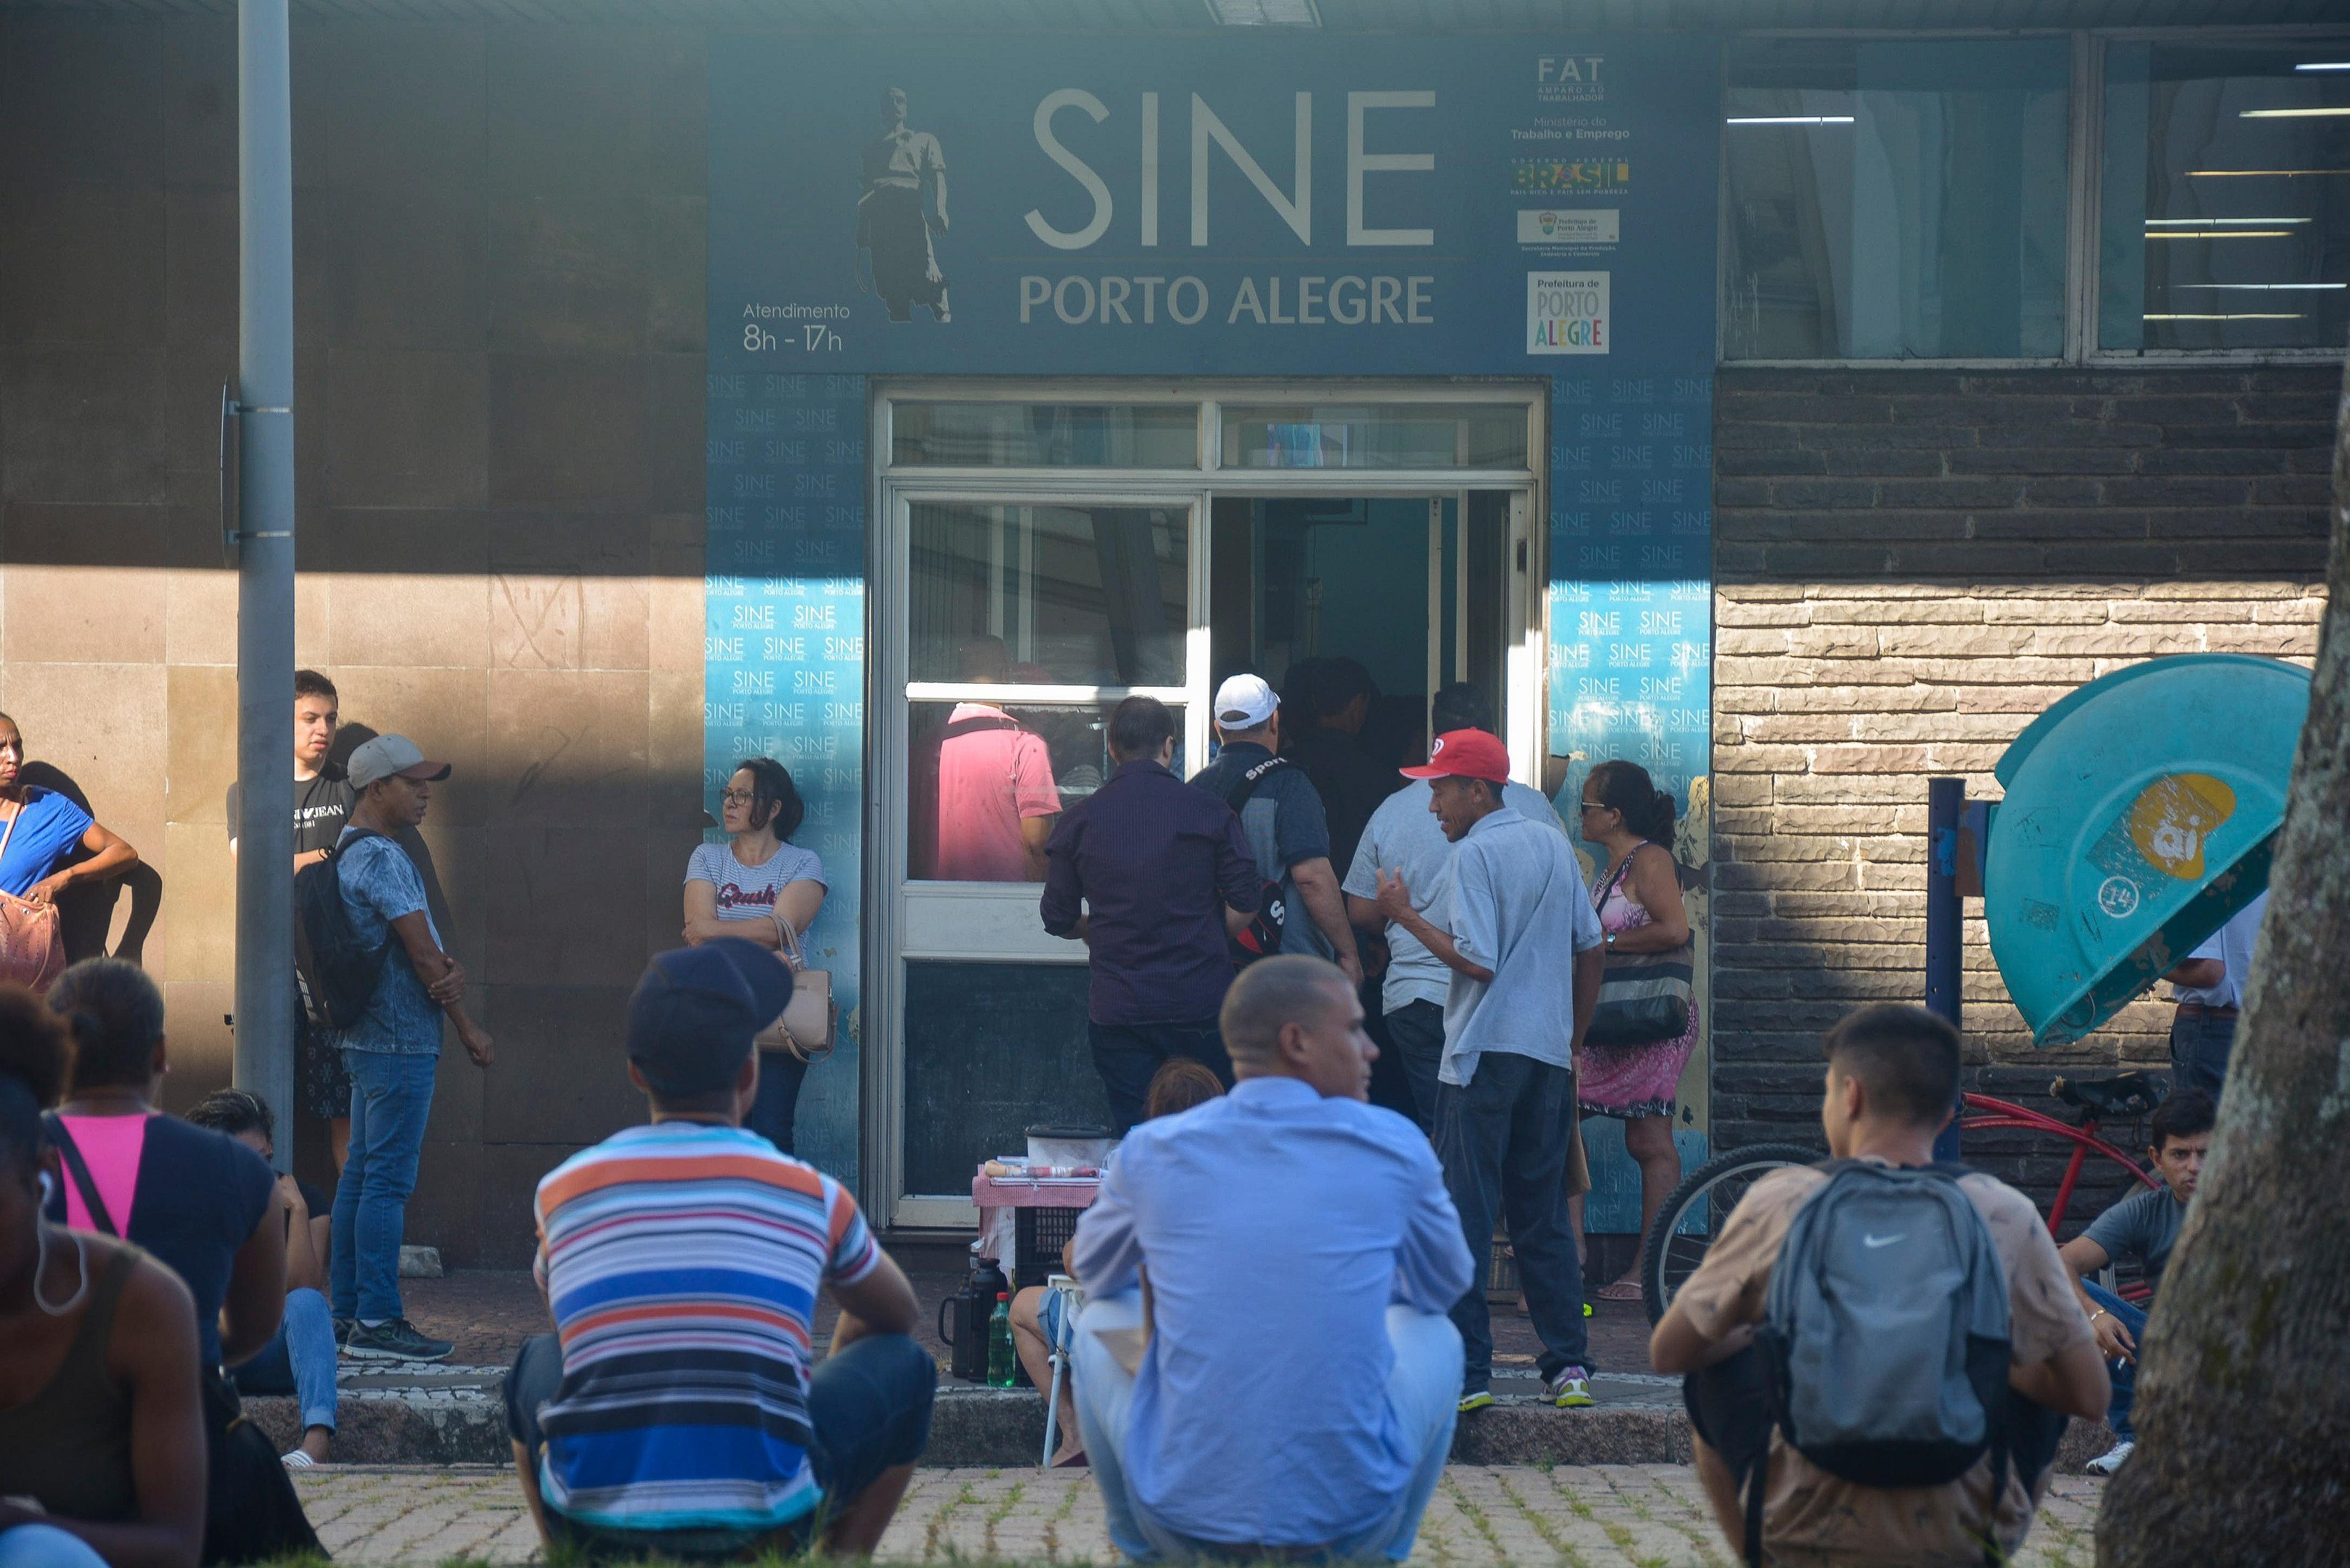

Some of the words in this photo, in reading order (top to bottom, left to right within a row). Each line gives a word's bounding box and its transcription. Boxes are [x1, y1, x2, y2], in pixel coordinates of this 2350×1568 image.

[1538, 57, 1604, 82] FAT
[1591, 115, 1607, 127] do
[1511, 129, 1562, 140] Trabalho
[1565, 131, 1573, 139] e
[1576, 129, 1630, 141] Emprego
[1024, 88, 1436, 250] SINE
[1538, 279, 1585, 288] Prefeitura
[1587, 279, 1599, 288] de
[1019, 275, 1209, 325] PORTO
[1227, 275, 1435, 325] ALEGRE
[1537, 291, 1599, 317] PORTO
[743, 302, 850, 319] Atendimento
[743, 324, 776, 351] 8h
[804, 324, 842, 351] 17h
[1535, 319, 1602, 346] ALEGRE
[705, 572, 744, 589] SINE
[764, 572, 805, 589] SINE
[825, 572, 863, 589] SINE
[1549, 579, 1590, 595] SINE
[1609, 579, 1651, 595] SINE
[1671, 579, 1710, 595] SINE
[734, 605, 775, 623] SINE
[795, 605, 836, 623] SINE
[1579, 611, 1620, 629] SINE
[1640, 611, 1682, 629] SINE
[705, 637, 744, 654] SINE
[764, 637, 804, 654] SINE
[825, 637, 862, 654] SINE
[1549, 643, 1590, 661] SINE
[1609, 643, 1651, 661] SINE
[1671, 643, 1710, 661] SINE
[733, 671, 775, 688] SINE
[794, 671, 835, 688] SINE
[1578, 677, 1620, 695] SINE
[1640, 677, 1681, 695] SINE
[705, 703, 743, 720] SINE
[763, 703, 804, 720] SINE
[824, 703, 862, 720] SINE
[1671, 709, 1710, 726] SINE
[733, 736, 774, 754] SINE
[793, 736, 834, 754] SINE
[1639, 743, 1681, 759] SINE
[1246, 757, 1287, 780] Sport
[1670, 775, 1692, 791] SIN
[313, 804, 344, 818] JEAN
[804, 802, 835, 817] INE
